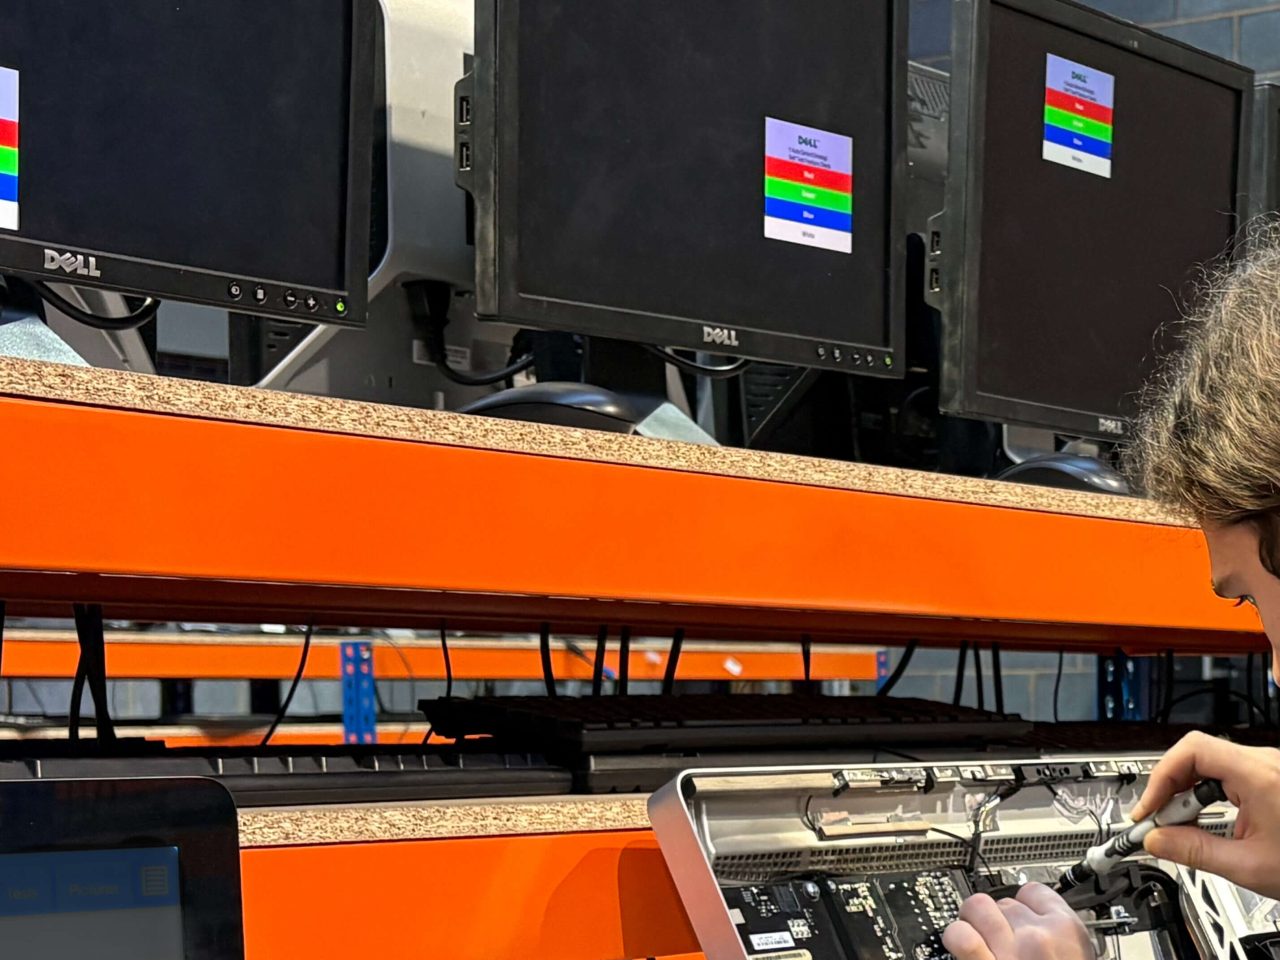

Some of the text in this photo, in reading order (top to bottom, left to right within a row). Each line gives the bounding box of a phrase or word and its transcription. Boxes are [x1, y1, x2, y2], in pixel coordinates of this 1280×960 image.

[44, 248, 101, 278] DELL
[703, 325, 739, 347] DELL
[1098, 418, 1123, 434] DELL
